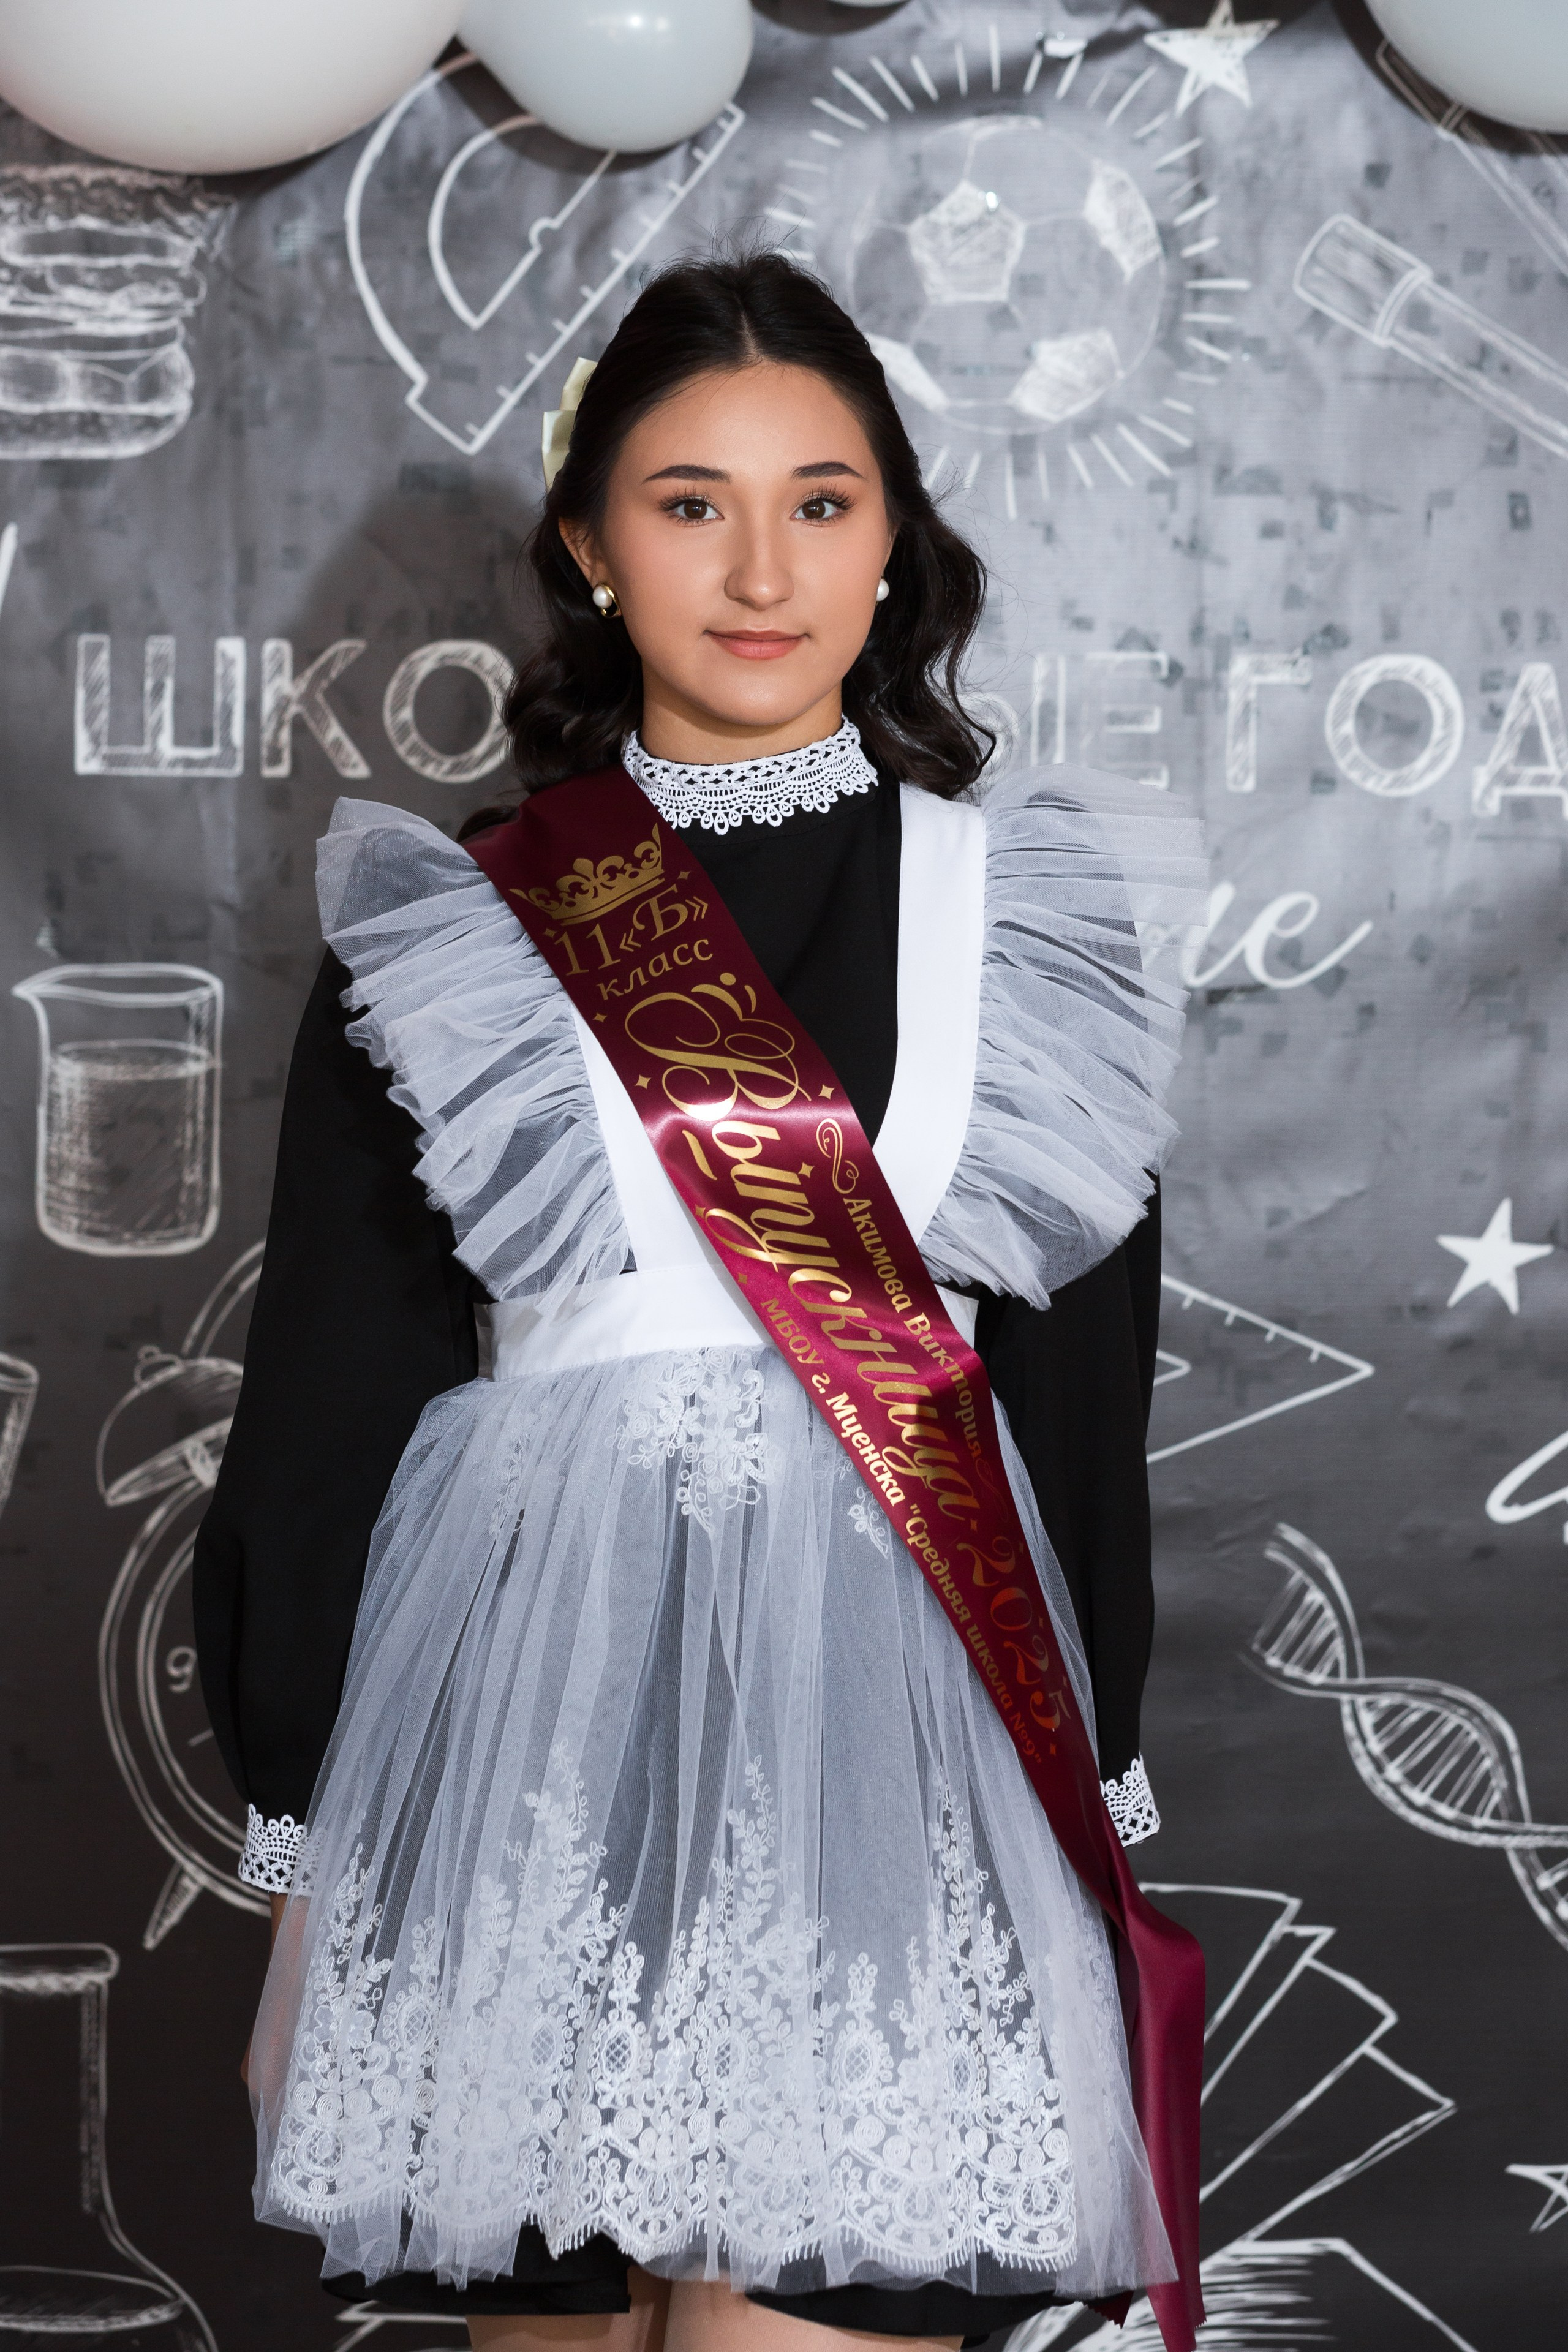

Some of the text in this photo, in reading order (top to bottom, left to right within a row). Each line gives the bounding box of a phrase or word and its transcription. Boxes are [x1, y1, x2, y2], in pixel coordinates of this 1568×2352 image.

[597, 938, 714, 1001] класс
[624, 972, 1071, 1730] Выпускница 2025
[843, 1196, 982, 1458] Акимова Виктория
[760, 1298, 825, 1366] МБОУ
[811, 1373, 826, 1394] г.
[826, 1390, 906, 1507] Мценска
[905, 1502, 972, 1624] "Средняя
[965, 1623, 1014, 1711] школа
